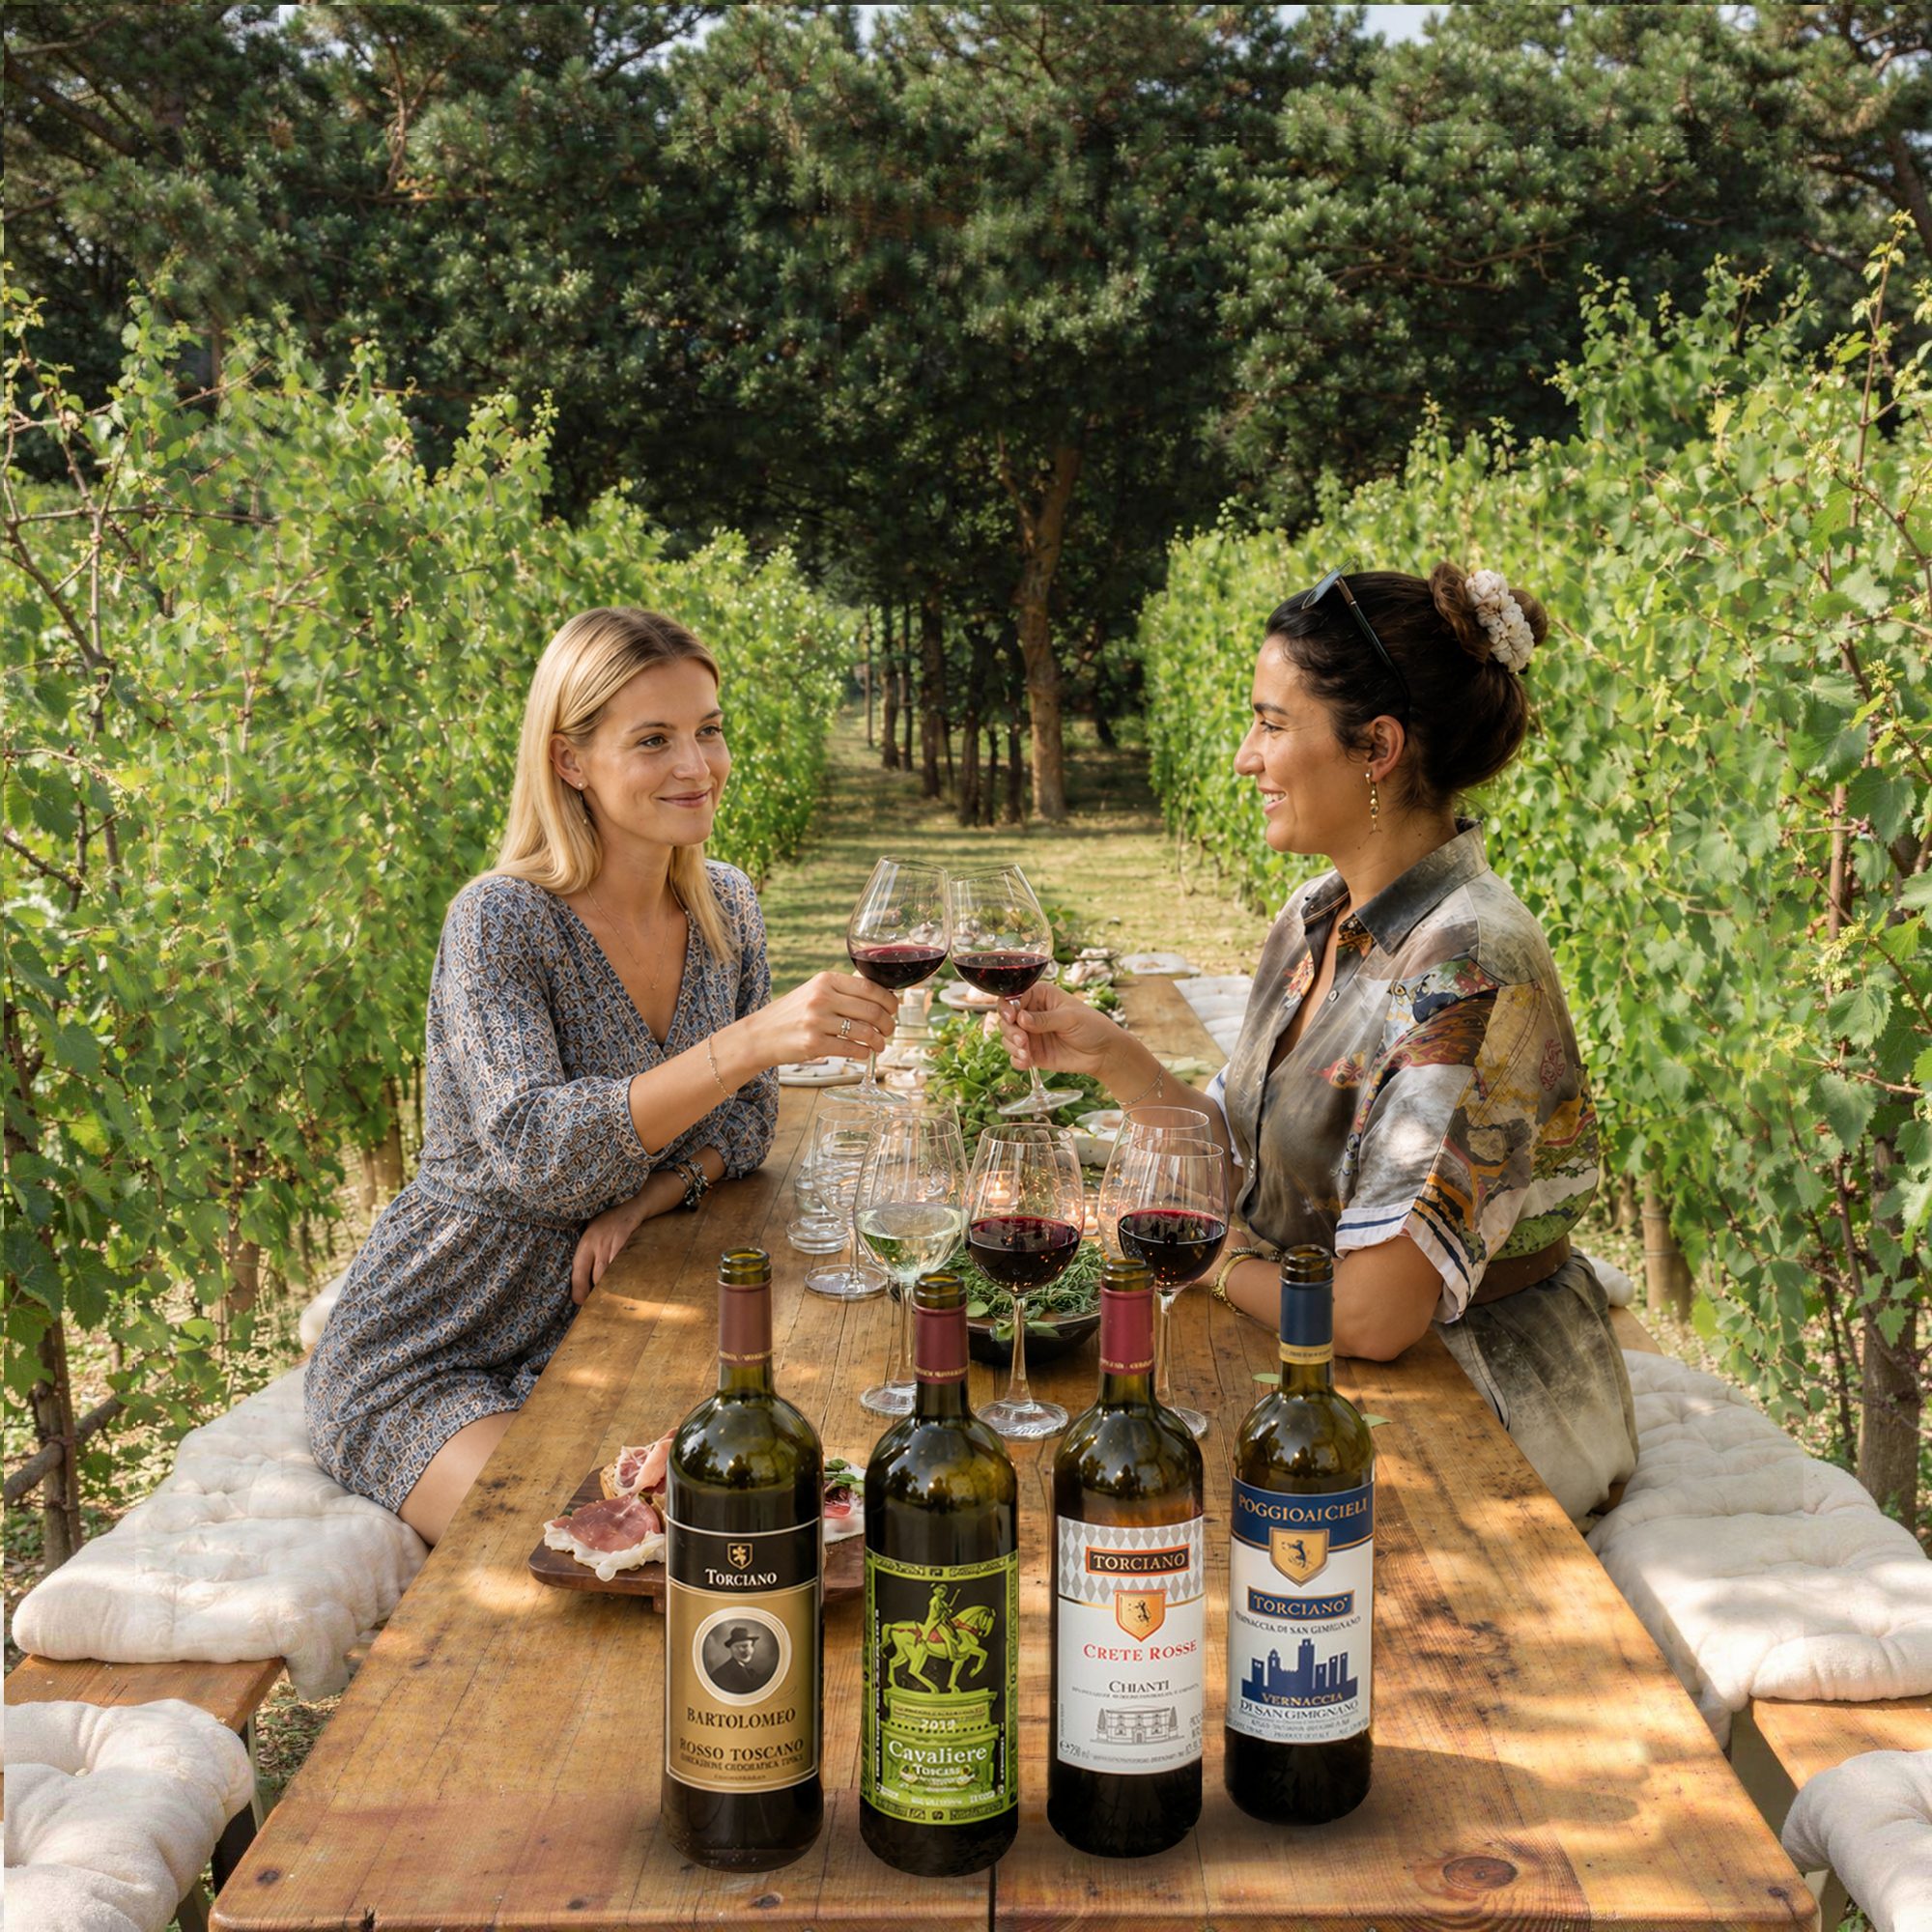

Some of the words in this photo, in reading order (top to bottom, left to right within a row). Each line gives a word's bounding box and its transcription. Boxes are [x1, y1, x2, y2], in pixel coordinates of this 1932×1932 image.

[1094, 1551, 1185, 1571] TORCIANO
[705, 1568, 777, 1586] TORCIANO
[1254, 1595, 1346, 1616] TORCIANO
[1084, 1643, 1143, 1662] CRETE
[1150, 1639, 1197, 1661] ROSSE
[1109, 1680, 1169, 1693] CHIANTI
[1240, 1698, 1252, 1712] DI
[1254, 1704, 1283, 1719] SAN
[1262, 1692, 1343, 1707] VERNACCIA
[687, 1706, 796, 1729] BARTOLOMEO
[680, 1738, 724, 1760] ROSSO
[730, 1739, 804, 1761] TOSCANO
[889, 1740, 987, 1764] Cavaliere
